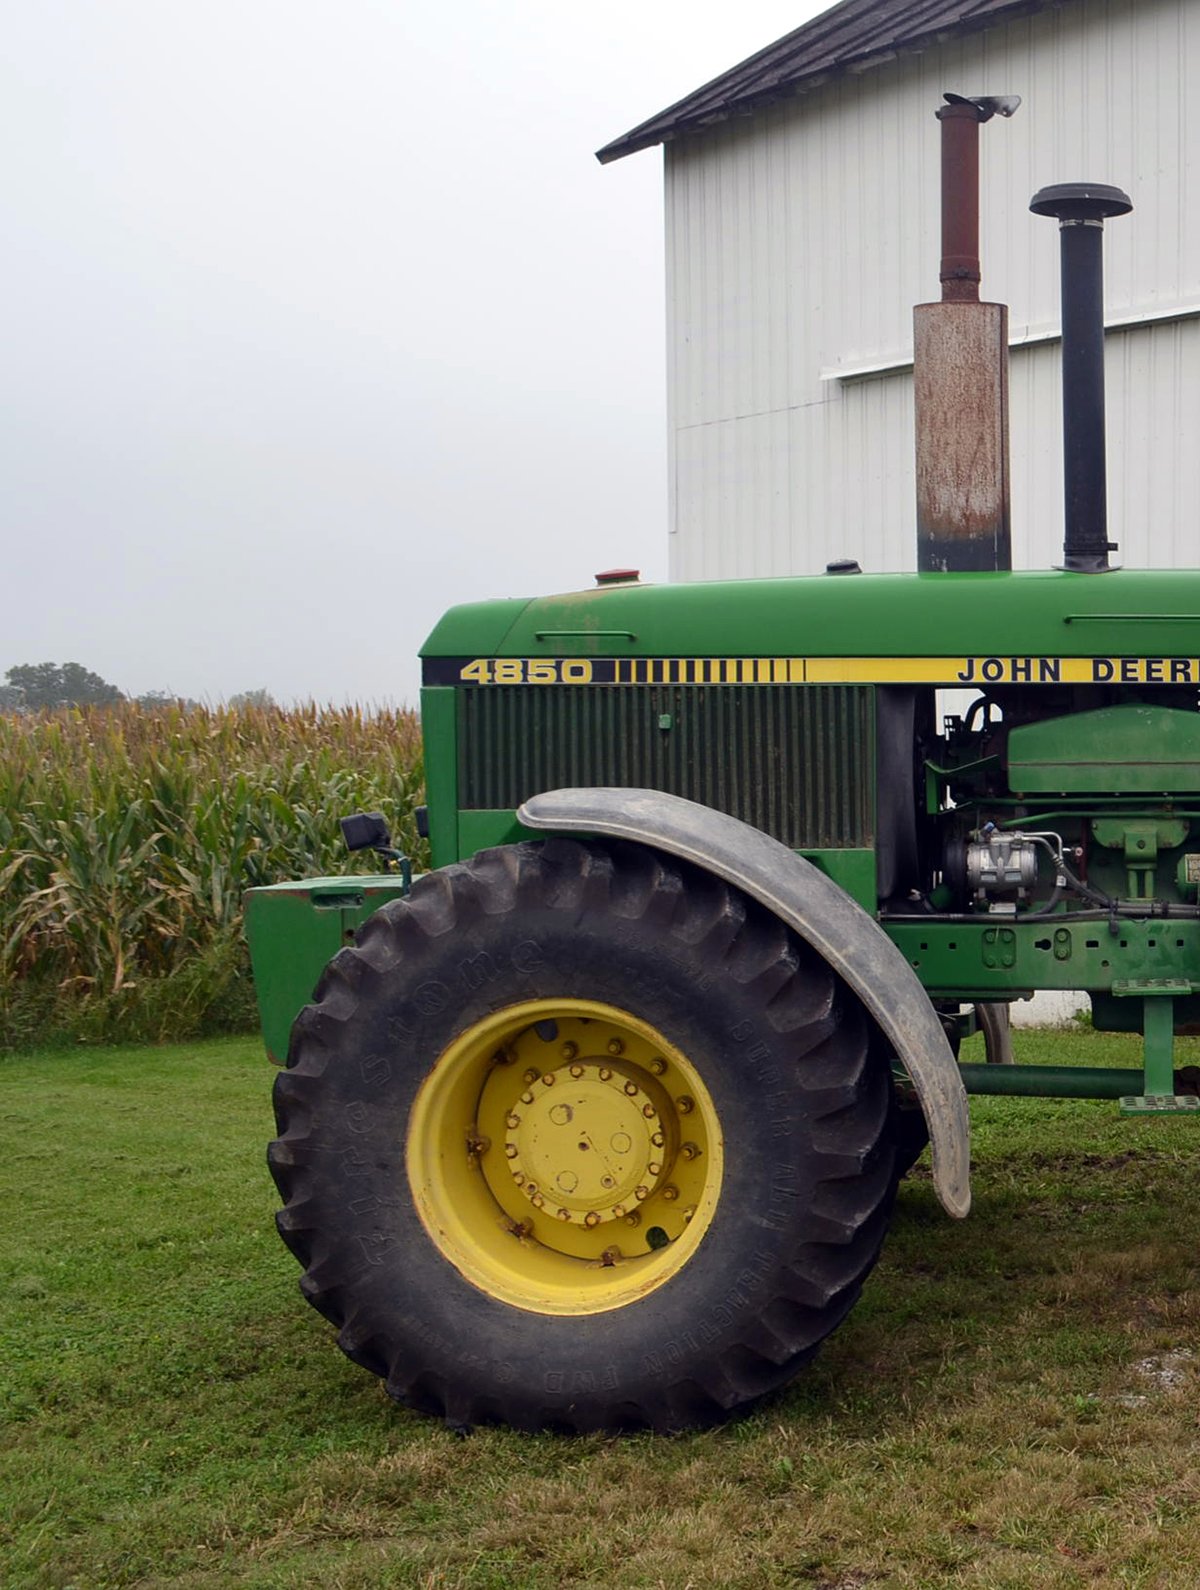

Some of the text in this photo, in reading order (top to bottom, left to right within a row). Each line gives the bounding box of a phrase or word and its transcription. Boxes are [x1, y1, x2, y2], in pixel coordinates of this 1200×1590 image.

[460, 658, 593, 685] 4850
[957, 658, 1061, 682] JOHN
[644, 1250, 781, 1377] TRACTION
